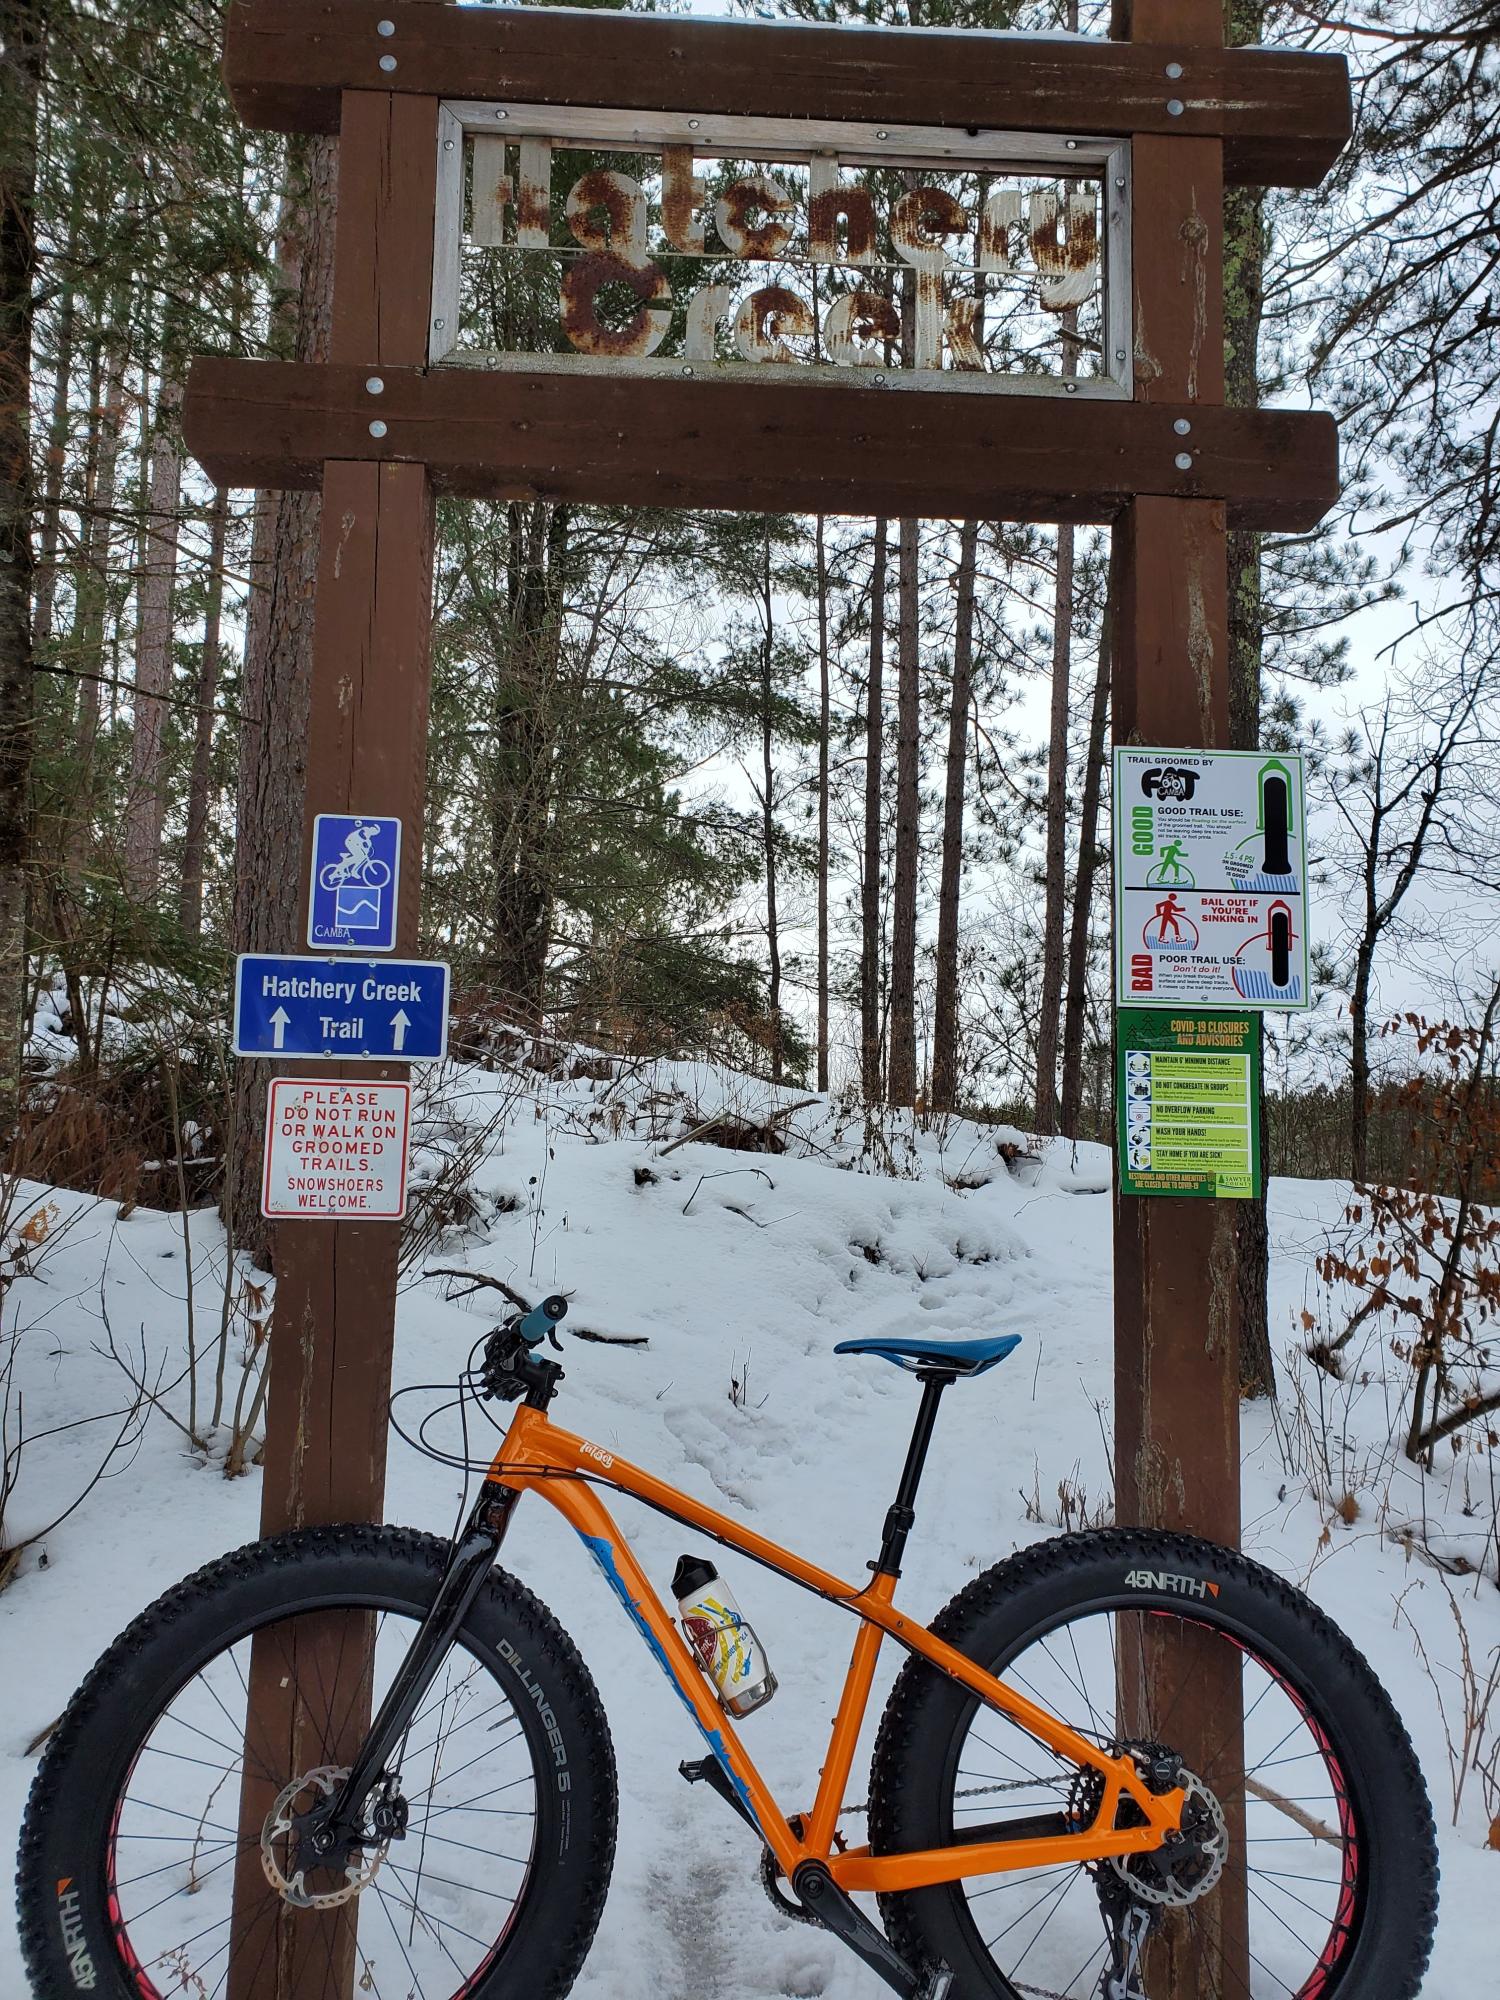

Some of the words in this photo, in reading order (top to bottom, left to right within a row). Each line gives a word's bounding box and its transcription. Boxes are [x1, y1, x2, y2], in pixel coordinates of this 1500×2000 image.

[472, 134, 1099, 313] Hatchery
[559, 250, 990, 374] Creek
[1127, 756, 1153, 764] TRAIL
[1154, 757, 1200, 766] GROOMED
[1157, 806, 1187, 816] GOOD
[1189, 807, 1218, 817] TRAIL
[1220, 809, 1244, 817] USE:
[1132, 806, 1154, 856] GOOD
[1201, 898, 1226, 907] BAIL
[1227, 899, 1248, 907] OUT
[1249, 899, 1259, 908] IF
[1211, 906, 1249, 916] YOU'RE
[1201, 914, 1245, 924] SINKING
[1247, 915, 1259, 924] IN
[314, 924, 351, 938] CAMBA
[1159, 954, 1188, 964] POOR
[1190, 955, 1220, 965] TRAIL
[1222, 956, 1246, 966] USE:
[1131, 954, 1153, 991] BAD
[1172, 964, 1197, 973] Don't
[1198, 965, 1210, 973] do
[1211, 965, 1221, 973] it!
[262, 975, 357, 1004] Hatchery
[362, 978, 422, 1003] Creek
[319, 1016, 364, 1039] Trail
[1170, 1020, 1207, 1033] COVID-19
[1208, 1020, 1250, 1034] CLOSURES
[1176, 1033, 1194, 1046] AND
[1195, 1034, 1244, 1047] ADVISORIES
[1154, 1055, 1179, 1064] MAINTAIN
[1184, 1056, 1207, 1065] MINIMUM
[1207, 1057, 1231, 1066] DISTANCE
[1155, 1081, 1162, 1089] DO
[1163, 1081, 1173, 1090] NOT
[1173, 1081, 1203, 1090] CONGREGATE
[1203, 1082, 1210, 1091] IN
[1210, 1083, 1229, 1091] GROUPS
[303, 1091, 379, 1106] PLEASE
[284, 1107, 309, 1120] DO
[315, 1107, 352, 1122] NOT
[358, 1109, 396, 1122] RUN
[1155, 1105, 1164, 1114] NO
[1164, 1105, 1192, 1115] OVERFLOW
[1192, 1106, 1215, 1115] PARKING
[281, 1123, 306, 1137] OR
[313, 1124, 365, 1138] WALK
[372, 1125, 396, 1139] ON
[1155, 1127, 1171, 1136] WASH
[1172, 1128, 1186, 1136] YOUR
[1186, 1128, 1207, 1137] HANDS!
[292, 1140, 384, 1155] GROOMED
[1156, 1150, 1168, 1158] STAY
[1168, 1150, 1183, 1158] HOME
[1183, 1150, 1188, 1158] IF
[1189, 1150, 1199, 1159] YOU
[1199, 1151, 1209, 1159] ARE
[1209, 1151, 1223, 1159] SICK!
[300, 1157, 374, 1172] TRAILS.
[287, 1177, 384, 1192] SNOWSHOERS
[298, 1194, 372, 1209] WELCOME.
[1124, 1570, 1207, 1599] 45NRTH
[495, 1638, 568, 1767] DILLINGER
[557, 1771, 572, 1792] 5
[58, 1891, 97, 1989] 45NRTH
